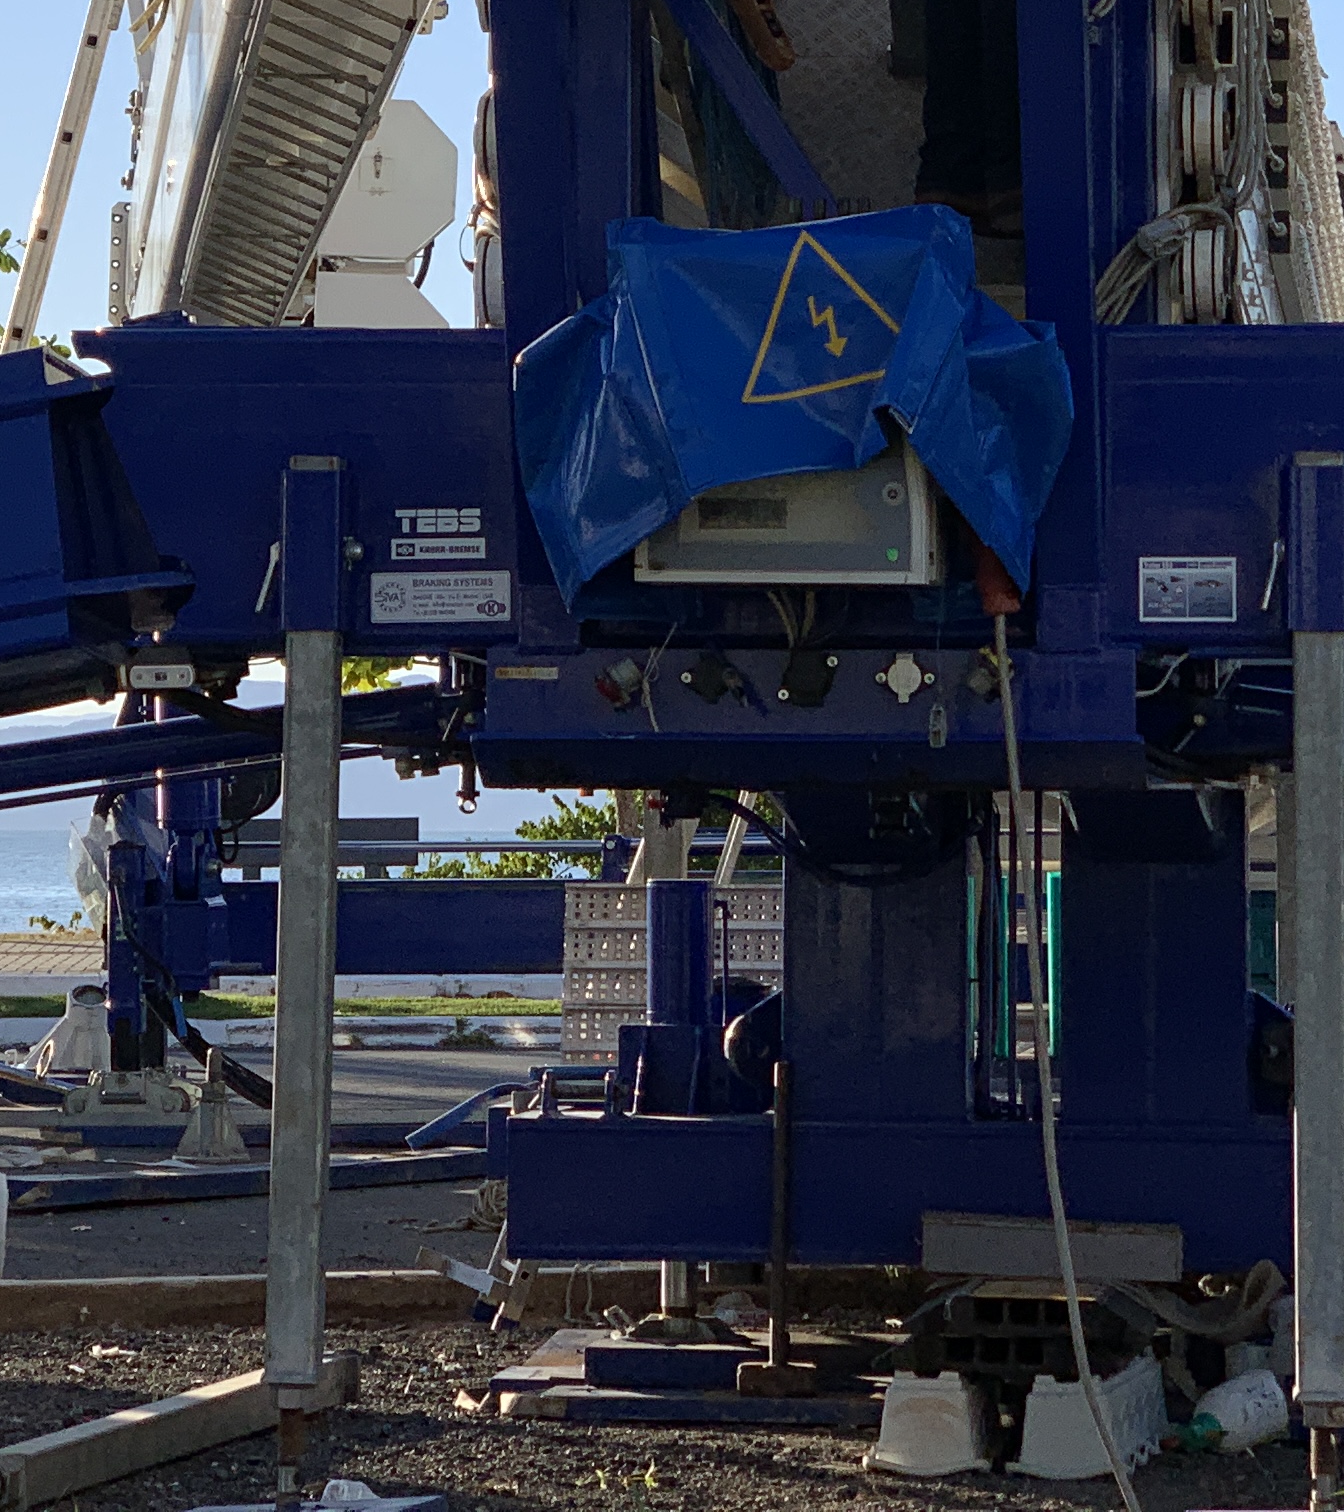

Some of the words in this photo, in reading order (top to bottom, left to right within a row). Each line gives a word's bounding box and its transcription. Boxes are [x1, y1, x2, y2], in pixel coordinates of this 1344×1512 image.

[394, 508, 482, 534] TEBS
[412, 578, 451, 587] BRAKING
[453, 577, 494, 587] SYSTEMS
